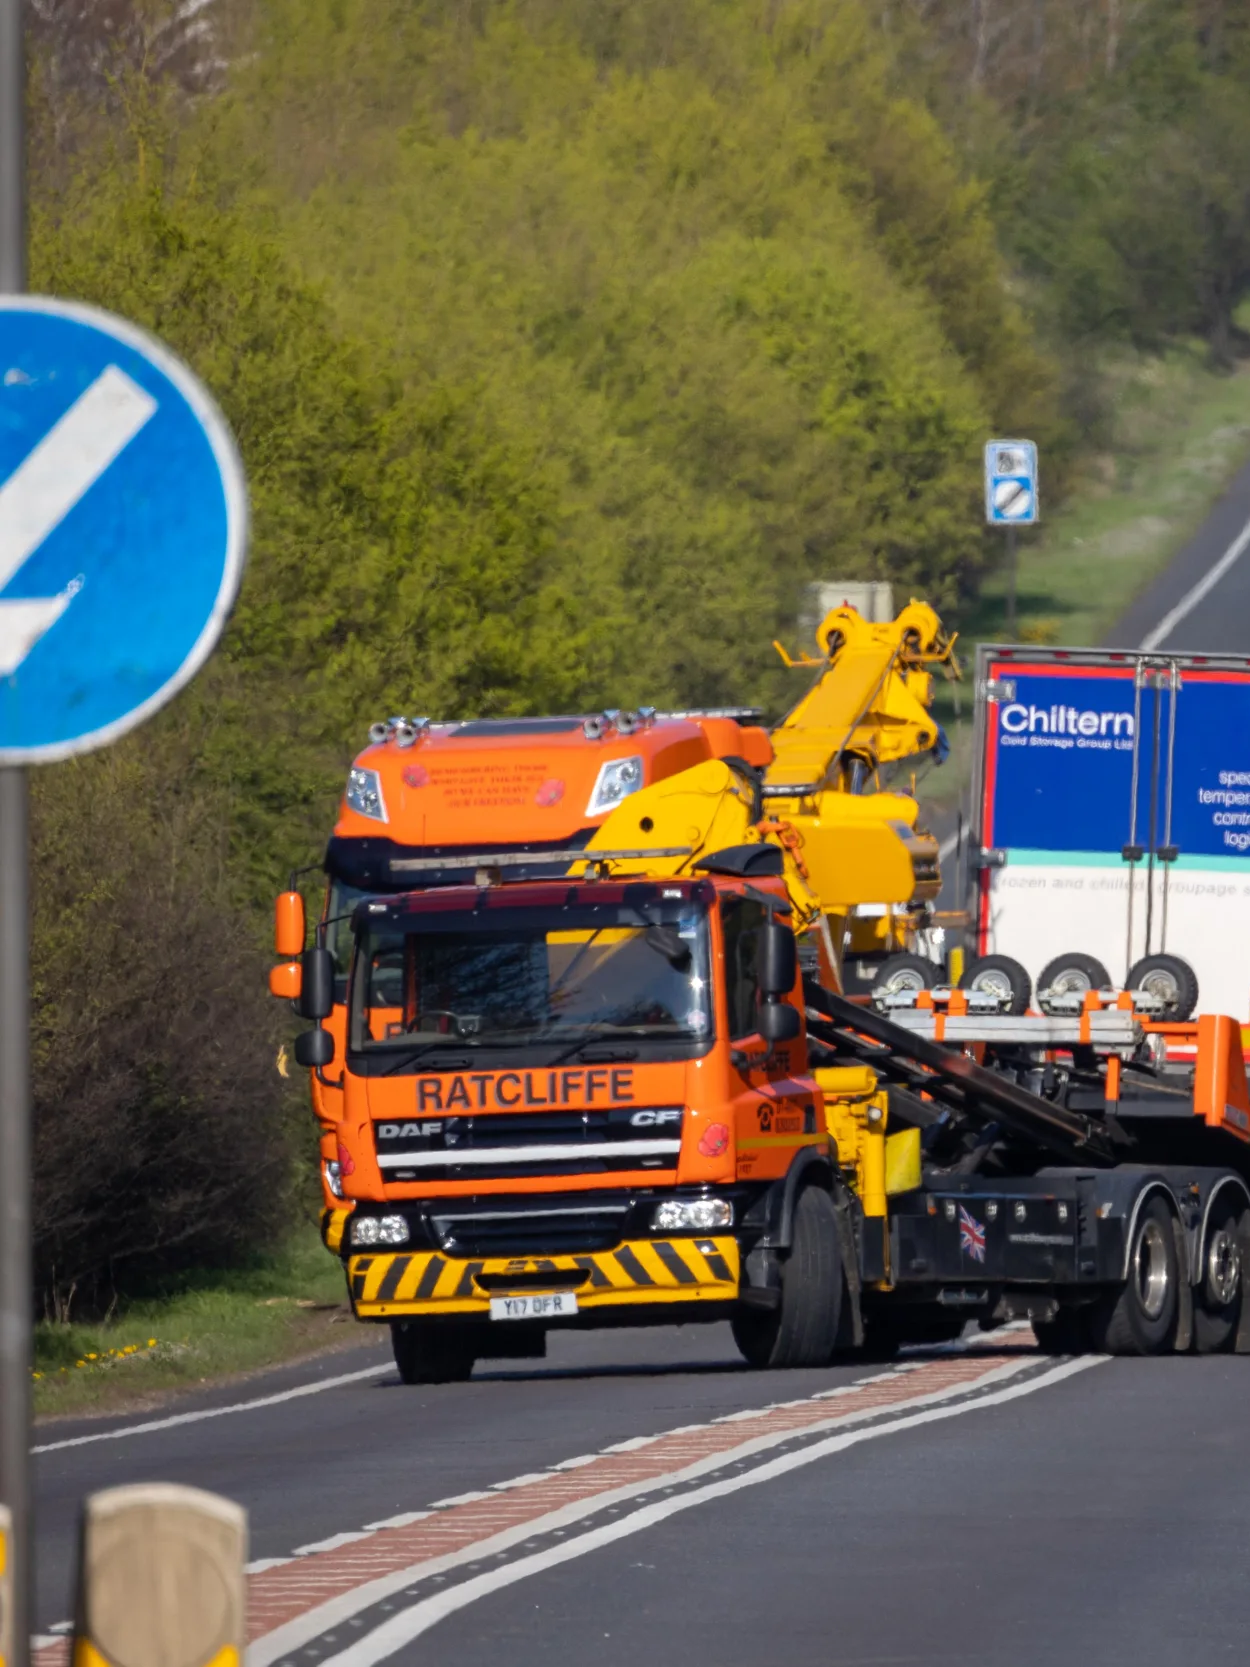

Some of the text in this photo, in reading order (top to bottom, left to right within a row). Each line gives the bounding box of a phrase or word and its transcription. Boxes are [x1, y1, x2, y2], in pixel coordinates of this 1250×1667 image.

[1001, 704, 1134, 736] Chiltern
[1000, 735, 1027, 746] Cold
[1029, 735, 1074, 749] Storage
[1076, 737, 1112, 750] Group
[1052, 877, 1084, 889] and
[417, 1069, 635, 1112] RATCLIFFE
[378, 1110, 683, 1140] DAF CF
[504, 1298, 528, 1316] Y17
